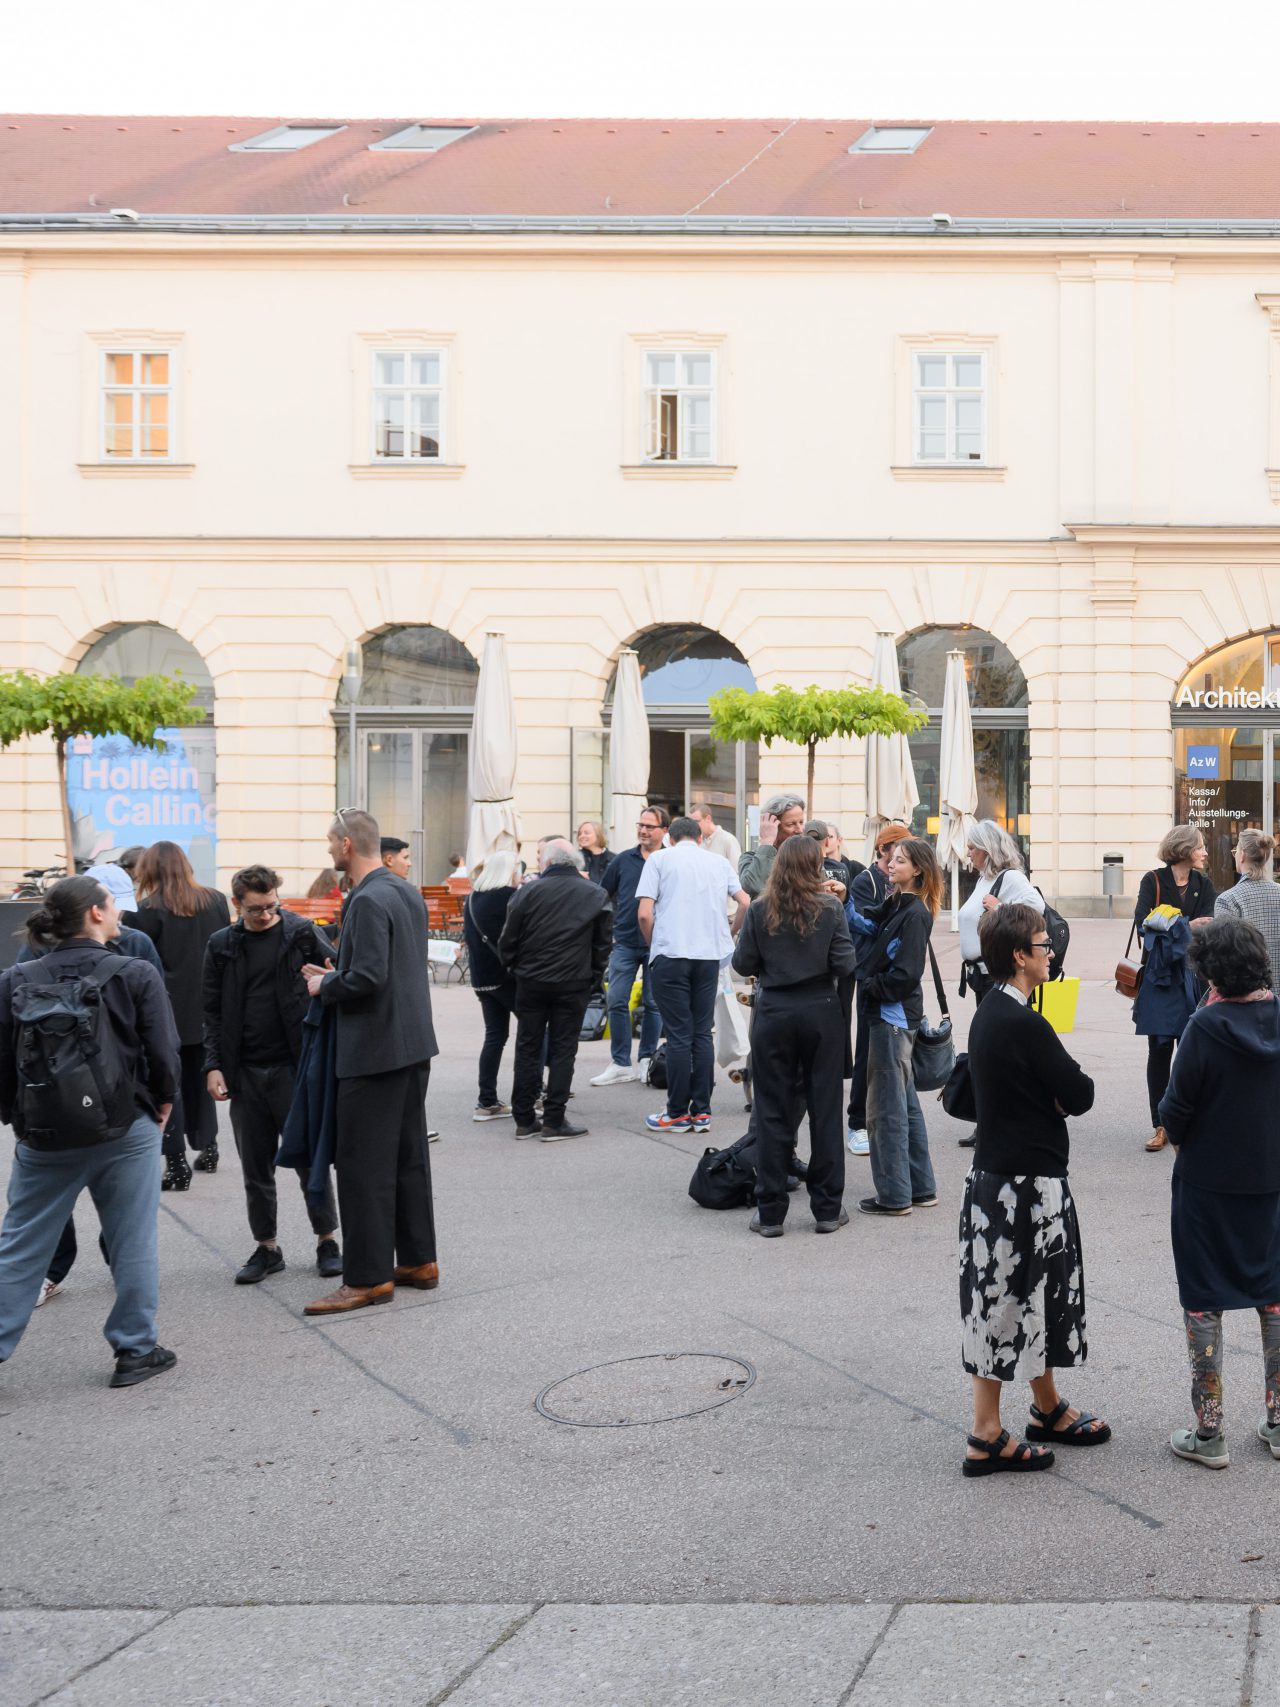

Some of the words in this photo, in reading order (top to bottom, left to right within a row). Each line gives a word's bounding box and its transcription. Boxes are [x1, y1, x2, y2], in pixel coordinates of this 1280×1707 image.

[82, 758, 199, 790] Hollein
[1188, 786, 1220, 796] Kassa/
[1189, 797, 1210, 807] Info/
[105, 794, 217, 833] Calling
[1188, 808, 1249, 820] Ausstellungs-
[1188, 819, 1210, 828] halle
[1211, 819, 1216, 828] 1
